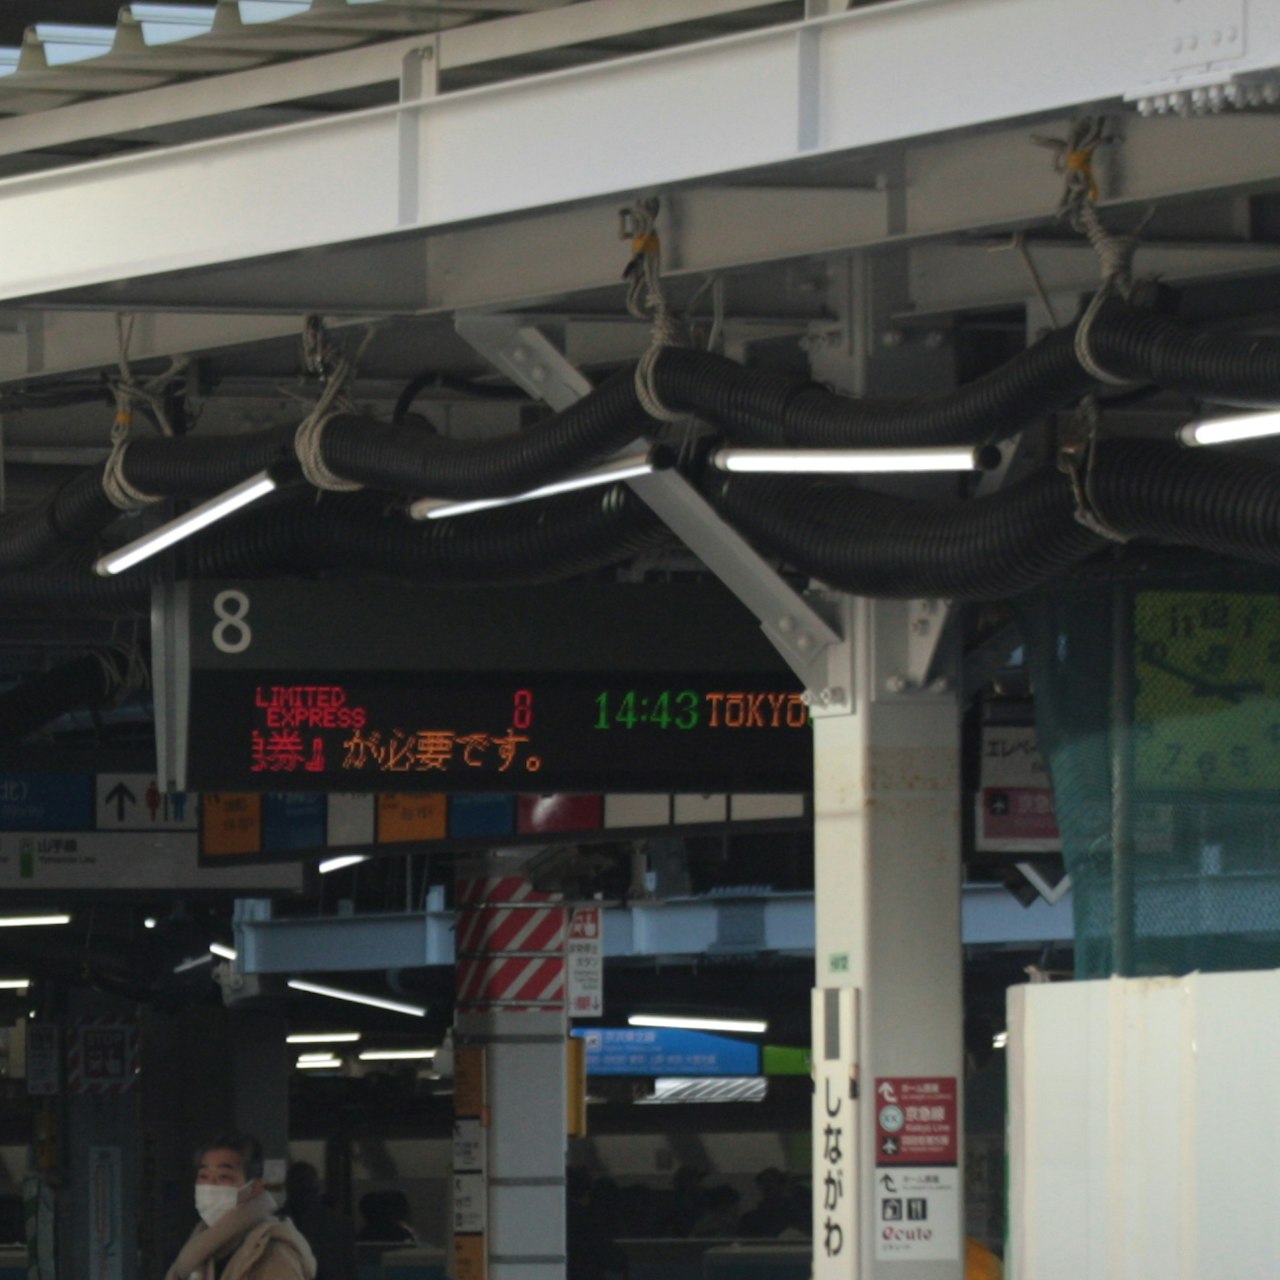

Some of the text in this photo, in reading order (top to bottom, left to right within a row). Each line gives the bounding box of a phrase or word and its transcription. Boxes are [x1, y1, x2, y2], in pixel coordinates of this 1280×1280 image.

[212, 589, 252, 655] 8
[255, 685, 347, 708] LIMITED
[594, 690, 701, 730] 14:43
[266, 708, 367, 729] EXPRESS
[823, 1075, 844, 1257] しながわ
